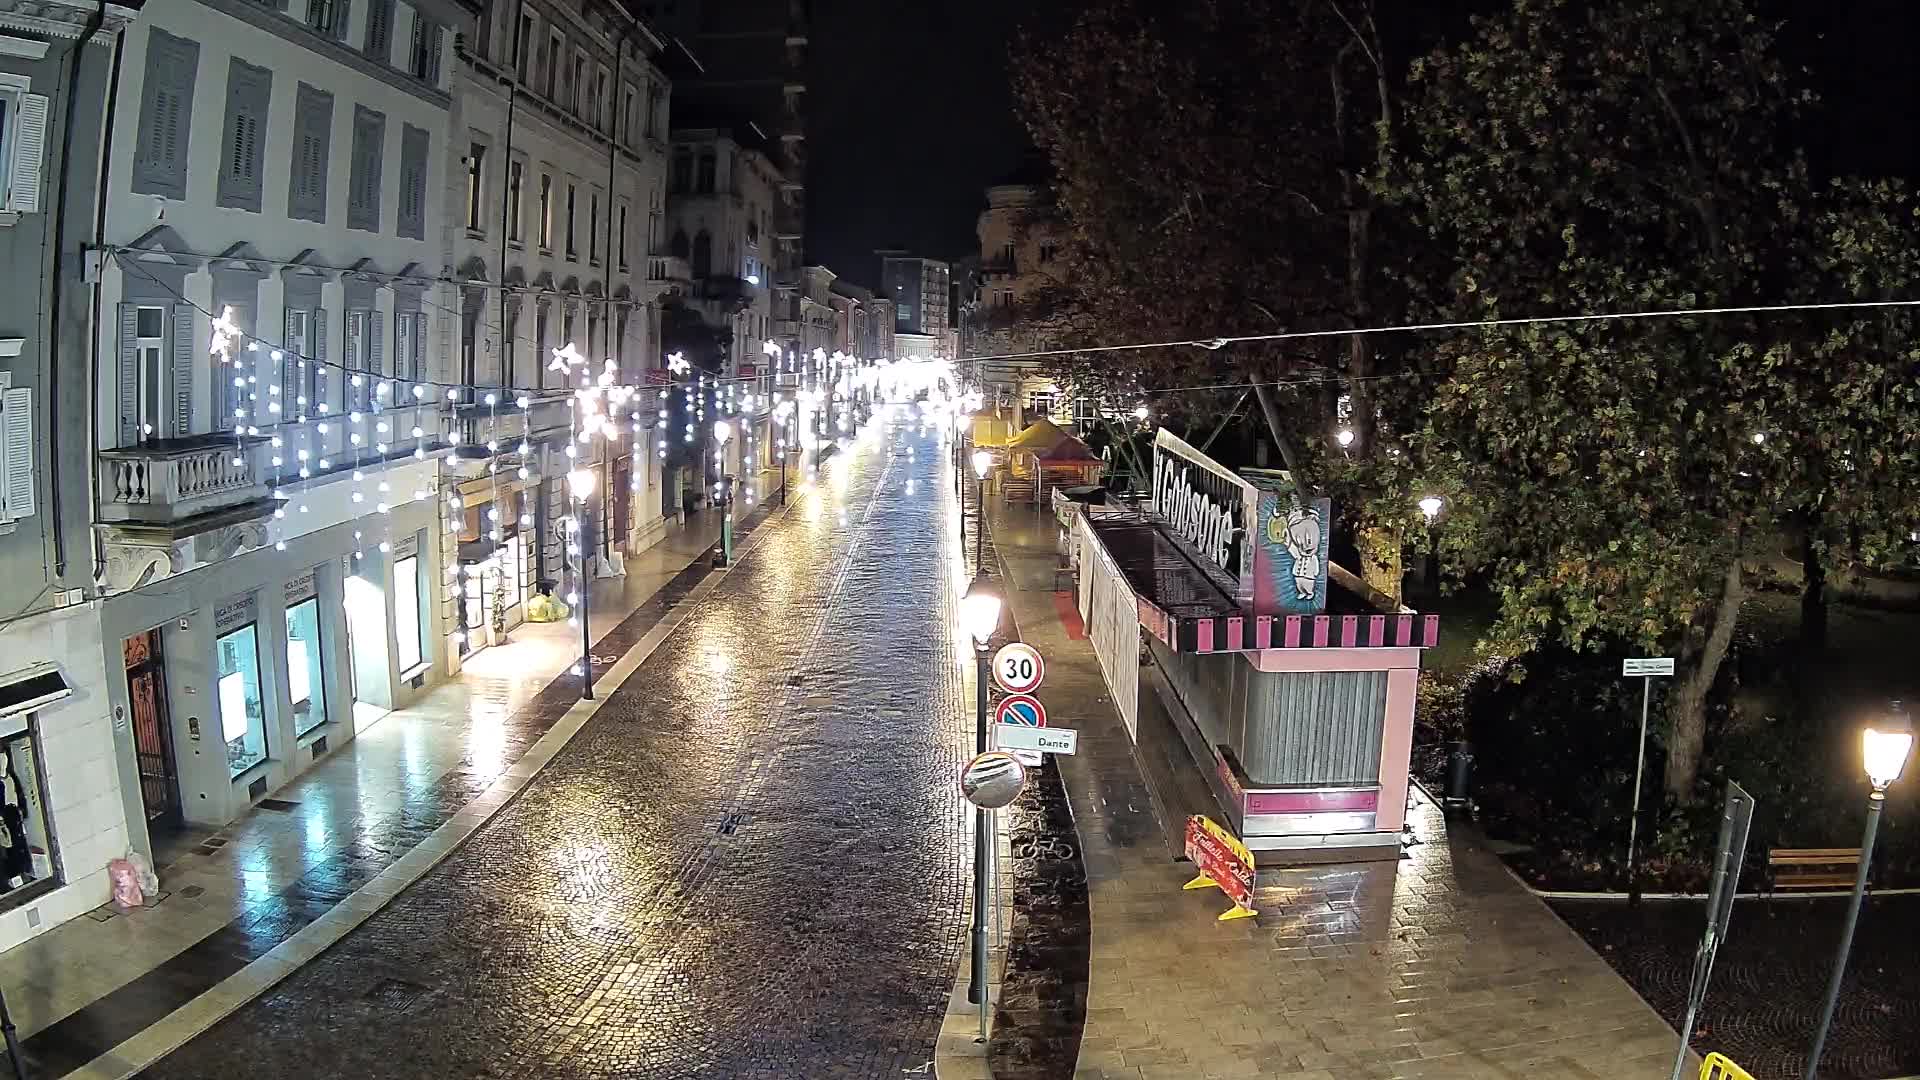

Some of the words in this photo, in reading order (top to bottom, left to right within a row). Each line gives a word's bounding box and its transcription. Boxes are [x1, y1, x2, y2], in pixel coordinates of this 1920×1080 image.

[1162, 458, 1232, 570] Golosone
[1006, 658, 1032, 680] 30
[1038, 737, 1070, 749] Dante
